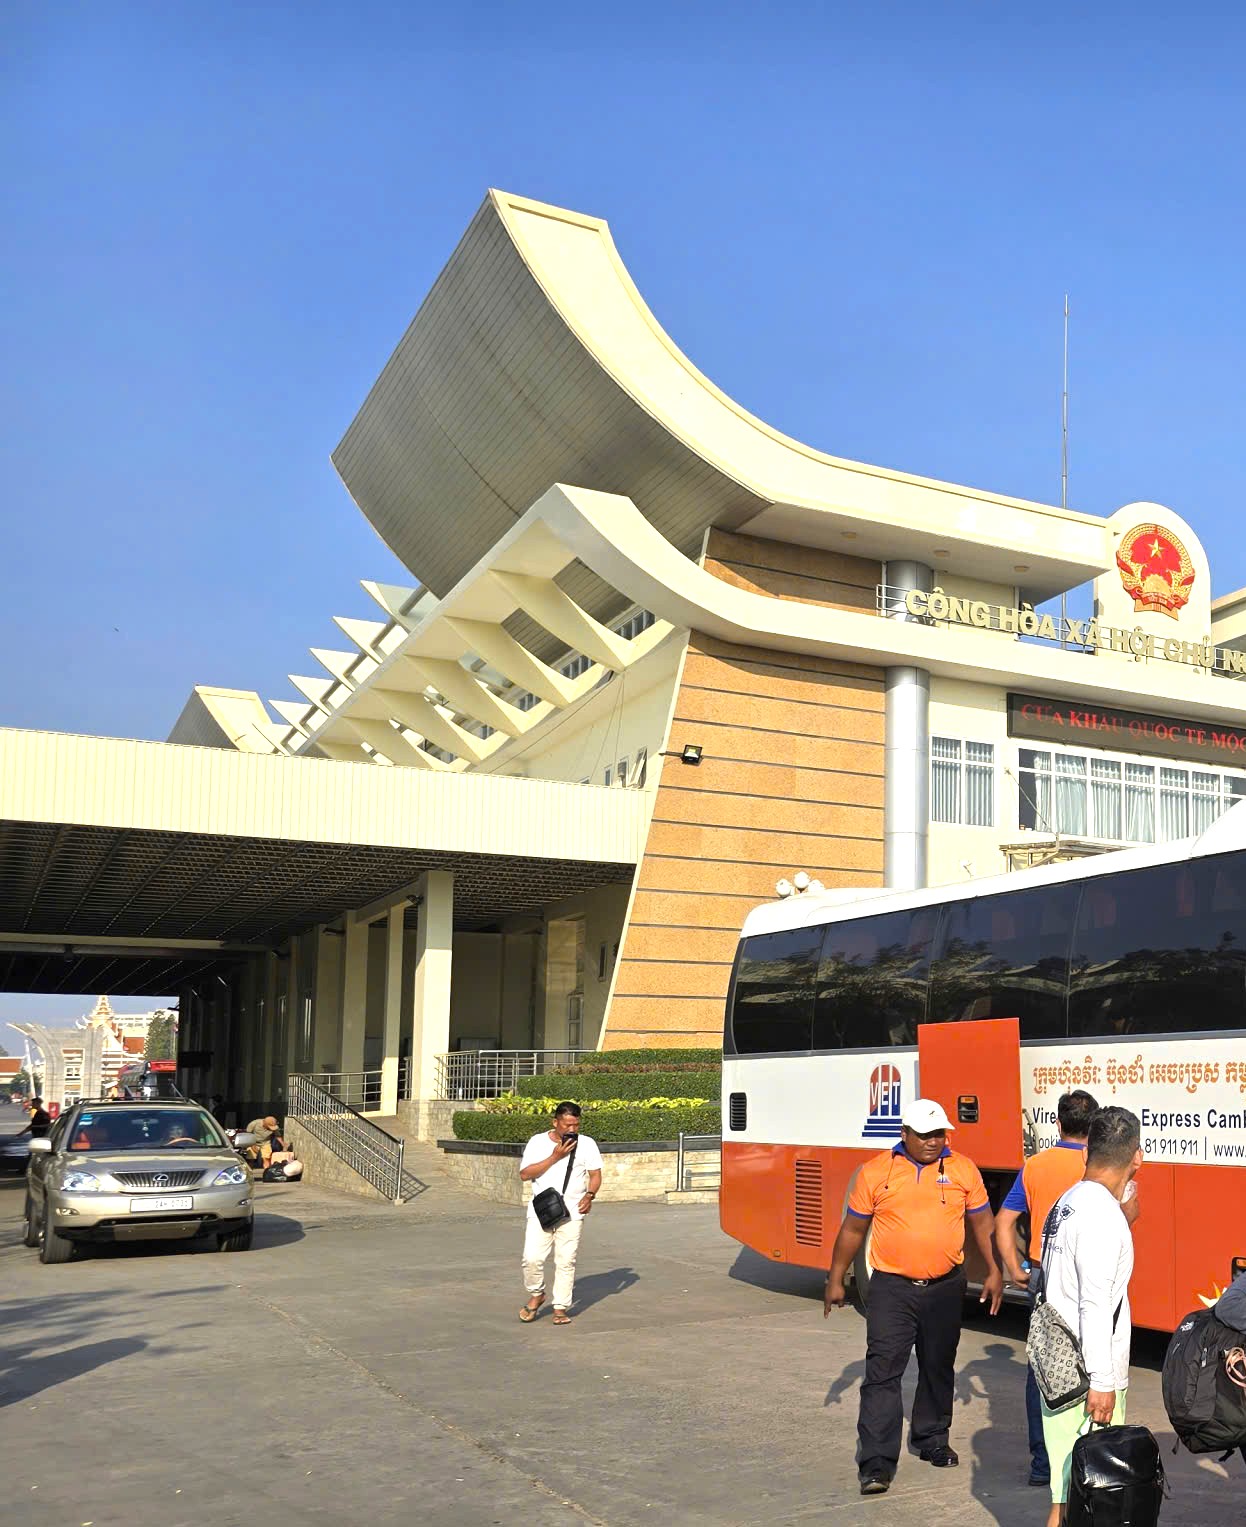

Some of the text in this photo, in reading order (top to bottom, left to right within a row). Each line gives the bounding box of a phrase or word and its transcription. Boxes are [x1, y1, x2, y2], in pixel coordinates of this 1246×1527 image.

[905, 586, 991, 628] CÔNG
[999, 603, 1056, 639] HÒA
[1066, 616, 1103, 648] XÃ
[1110, 626, 1154, 662] HỘI
[1164, 635, 1215, 668] CHỦ
[1032, 1107, 1057, 1125] Vire
[1141, 1108, 1201, 1131] Express
[1039, 1134, 1058, 1149] ooki
